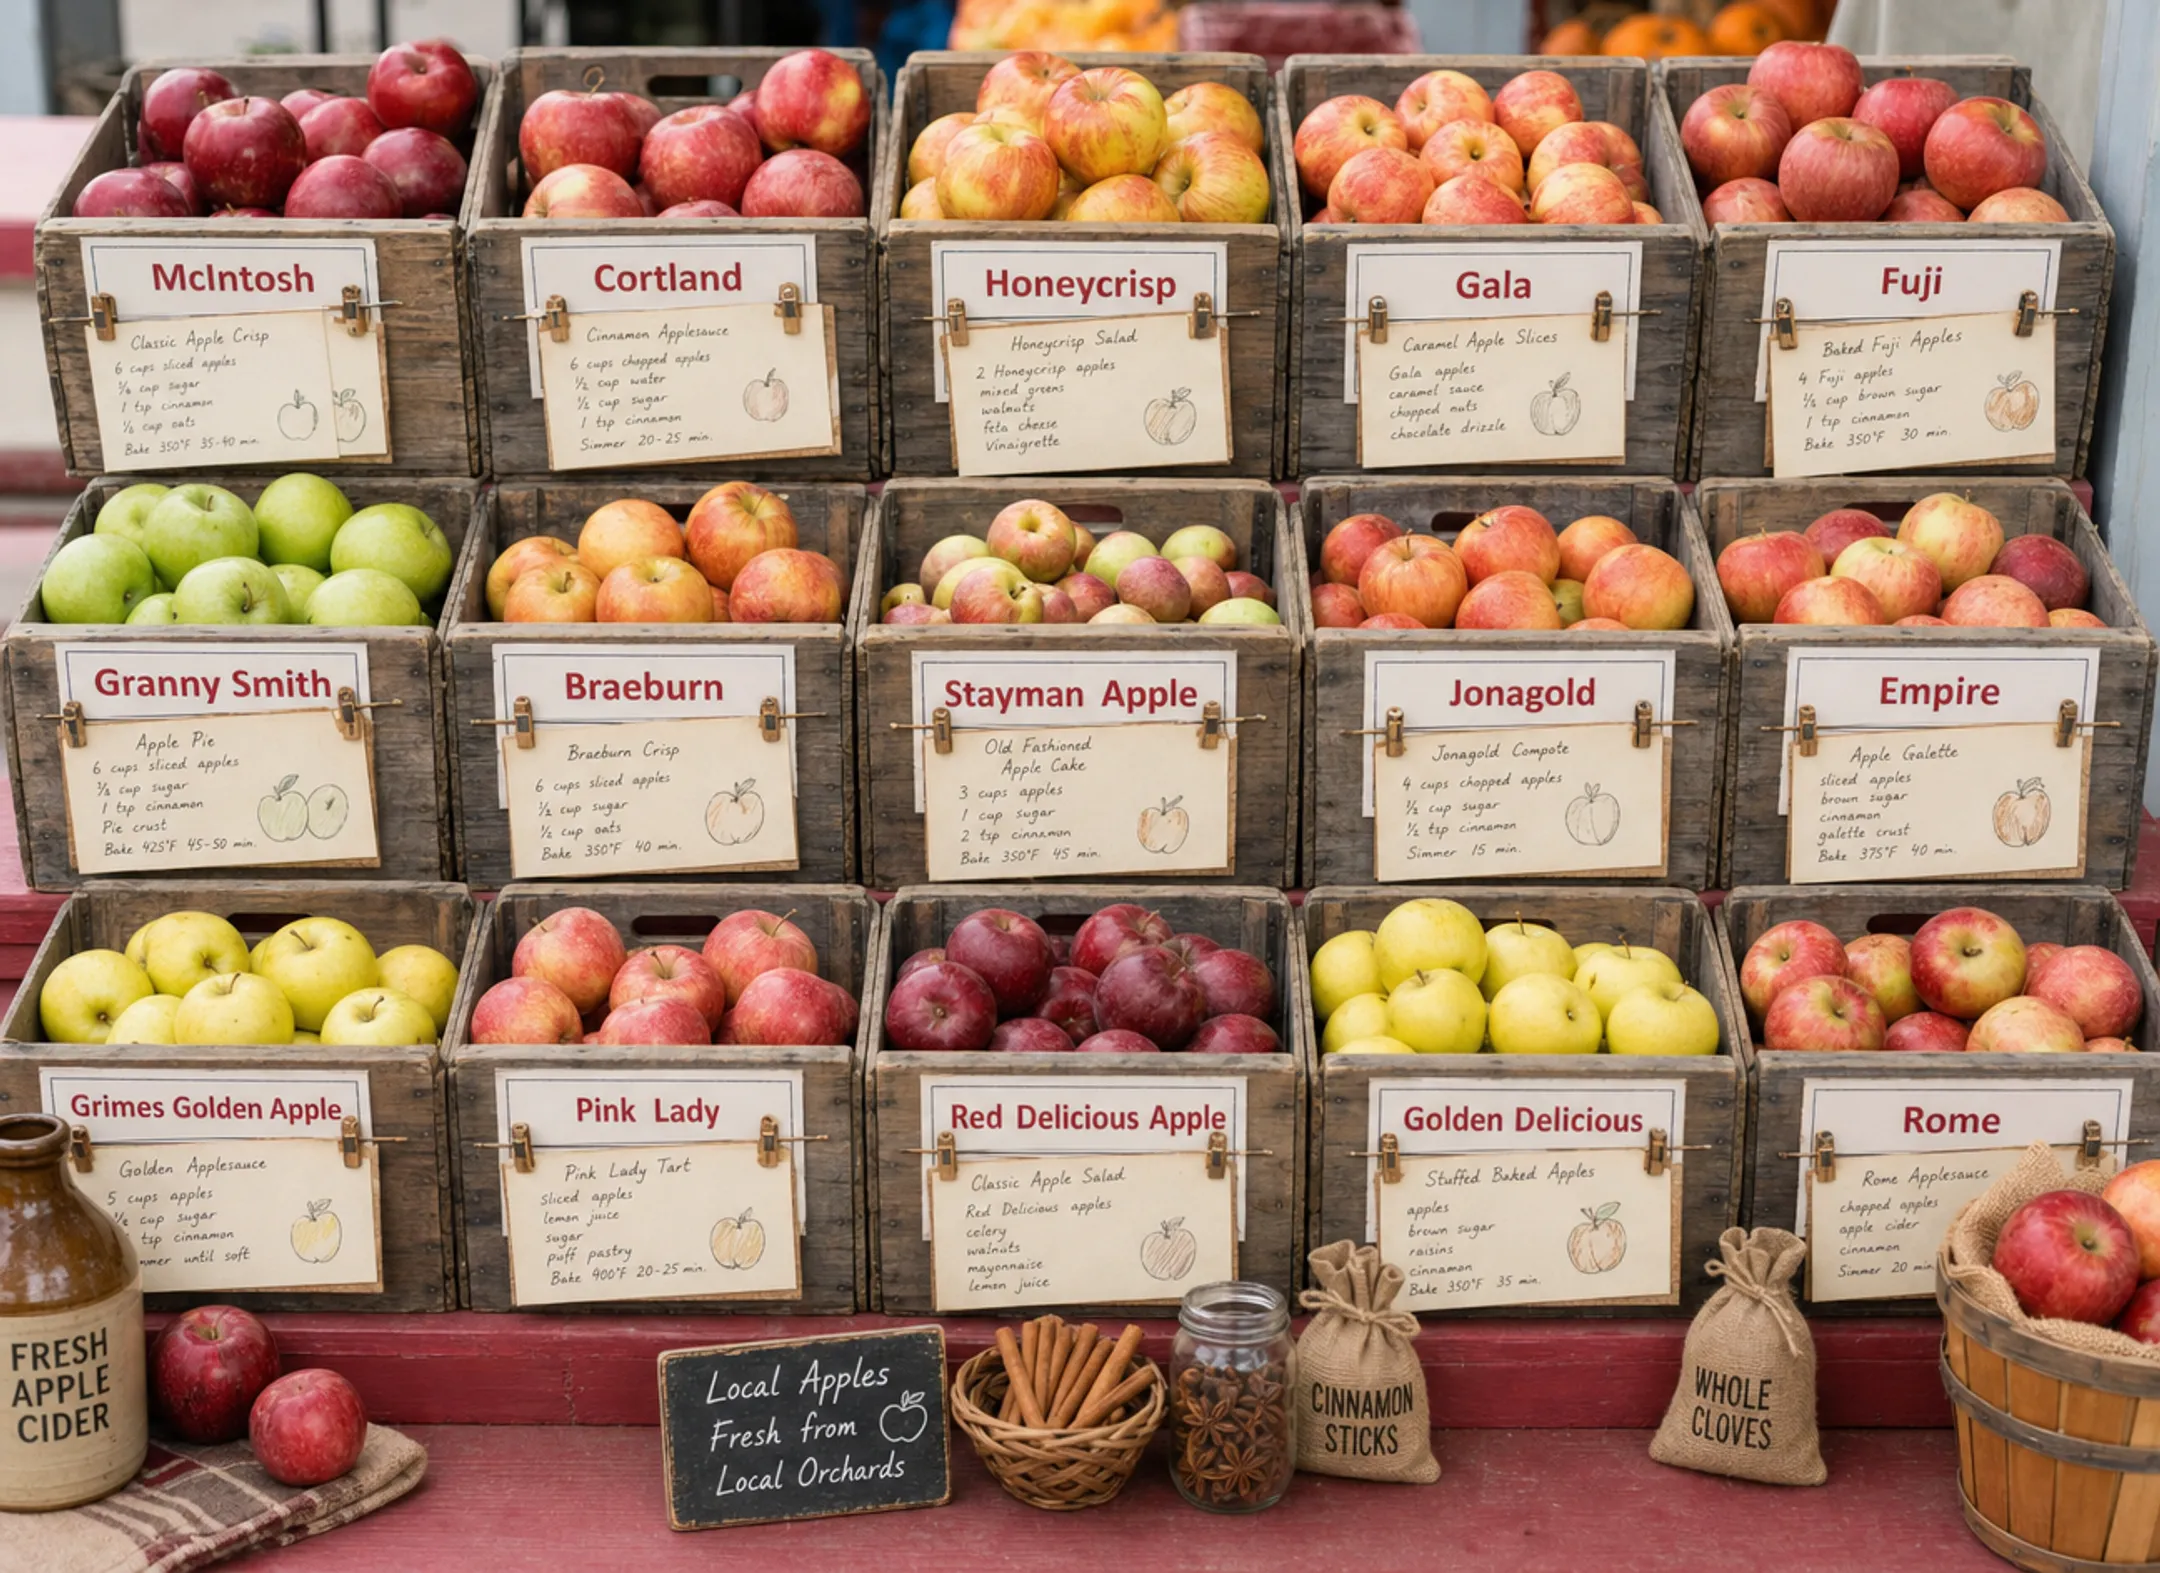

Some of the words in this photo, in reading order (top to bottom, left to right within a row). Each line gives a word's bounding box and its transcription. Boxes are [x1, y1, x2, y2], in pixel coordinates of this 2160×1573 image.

[152, 263, 314, 292] McIntosh
[594, 262, 742, 292] Cortland
[986, 268, 1176, 305] Honeycrisp
[1456, 270, 1531, 299] Gala
[1881, 266, 1942, 302] Fuji
[129, 334, 177, 352] Classic
[184, 328, 225, 353] Apple
[232, 326, 270, 348] Crisp
[586, 325, 650, 343] Cinnamon
[1010, 334, 1085, 358] Honeycrisp
[1094, 327, 1138, 346] Salad
[1402, 333, 1460, 353] Caramel
[1465, 330, 1505, 353] Apple
[1515, 327, 1558, 345] Slices
[1909, 326, 1962, 354] Apples
[200, 354, 237, 373] apples
[674, 349, 711, 368] apples
[993, 362, 1066, 383] Honeycrisp
[1075, 357, 1116, 378] apples
[1388, 364, 1422, 382] Gala
[1434, 360, 1476, 382] apples
[1853, 363, 1893, 385] apples
[631, 394, 668, 412] sugar
[1024, 384, 1065, 402] greens
[1904, 384, 1942, 403] sugar
[1389, 422, 1451, 440] chocolate
[1460, 417, 1506, 434] drizzle
[1900, 427, 1919, 442] 30
[579, 437, 626, 452] Simmer
[985, 434, 1060, 456] Vinaigrette
[94, 668, 220, 704] Granny
[232, 669, 331, 698] Smith
[565, 671, 723, 701] Braeburn
[945, 680, 1083, 714] Stayman
[1101, 678, 1197, 714] Apple
[1449, 677, 1595, 713] Jonagold
[1880, 676, 2000, 712] Empire
[134, 732, 180, 758] Apple
[191, 729, 215, 748] Pie
[566, 743, 632, 762] Braeburn
[642, 739, 680, 762] Crisp
[984, 737, 1013, 755] Old
[1021, 734, 1092, 754] Fashioned
[1431, 742, 1501, 768] Jonagold
[1511, 740, 1569, 761] Compote
[92, 760, 102, 775] 6
[148, 756, 188, 772] sliced
[196, 753, 240, 774] apples
[1848, 745, 1890, 770] Apple
[1901, 742, 1958, 762] Galette
[1000, 757, 1042, 782] Apple
[1050, 756, 1086, 773] Cake
[1520, 769, 1562, 790] apples
[1819, 772, 1859, 787] sliced
[1868, 770, 1912, 790] apples
[151, 782, 188, 798] sugar
[534, 777, 544, 793] 6
[588, 772, 624, 789] sliced
[631, 770, 671, 790] apples
[958, 784, 968, 800] 3
[1018, 781, 1063, 804] apples
[591, 801, 629, 818] sugar
[1015, 808, 1056, 826] sugar
[1461, 801, 1500, 818] sugar
[101, 819, 123, 834] Pie
[131, 817, 167, 833] crust
[1816, 825, 1866, 847] galette
[1875, 822, 1911, 838] crust
[634, 839, 652, 853] 40
[1052, 846, 1070, 860] 45
[1406, 844, 1457, 860] Simmer
[1471, 842, 1487, 856] 15
[1910, 843, 1928, 857] 40
[71, 1094, 164, 1118] Grimes
[173, 1095, 262, 1119] Golden
[270, 1096, 342, 1125] Apple
[577, 1097, 636, 1122] Pink
[655, 1097, 720, 1129] Lady
[951, 1103, 1002, 1129] Red
[1017, 1103, 1139, 1130] Delicious
[1149, 1104, 1226, 1136] Apple
[1404, 1105, 1502, 1131] Golden
[1515, 1106, 1643, 1132] Delicious
[1904, 1106, 2000, 1134] Rome
[118, 1158, 174, 1179] Golden
[564, 1163, 597, 1182] Pink
[608, 1159, 648, 1185] Lady
[656, 1156, 692, 1174] Tart
[970, 1173, 1020, 1192] Classic
[1029, 1169, 1072, 1193] Apple
[1081, 1165, 1126, 1184] Salad
[1424, 1167, 1481, 1188] Stuffed
[1546, 1161, 1595, 1185] Apples
[1861, 1169, 1898, 1187] Rome
[107, 1190, 117, 1206] 5
[169, 1185, 213, 1207] apples
[590, 1186, 633, 1208] apples
[964, 1203, 992, 1218] Red
[1001, 1201, 1059, 1217] Delicious
[1070, 1195, 1112, 1216] apples
[1899, 1194, 1938, 1215] apples
[176, 1211, 217, 1228] sugar
[543, 1211, 580, 1225] lemon
[1406, 1199, 1450, 1221] apples
[965, 1223, 1007, 1244] celery
[1457, 1223, 1496, 1240] sugar
[1838, 1219, 1874, 1239] apple
[1884, 1217, 1920, 1232] cider
[544, 1232, 584, 1251] sugar
[183, 1249, 215, 1264] until
[224, 1245, 250, 1263] soft
[586, 1244, 633, 1264] pastry
[1837, 1263, 1882, 1278] Simmer
[1890, 1260, 1908, 1274] 20
[968, 1278, 1007, 1292] lemon
[1496, 1274, 1513, 1288] 35
[11, 1327, 108, 1371] FRESH
[12, 1363, 110, 1407] APPLE
[706, 1364, 780, 1404] Local
[799, 1356, 890, 1406] Apples
[1696, 1365, 1772, 1411] WHOLE
[1311, 1381, 1413, 1419] CINNAMON
[18, 1402, 110, 1443] CIDER
[710, 1416, 781, 1452] Fresh
[800, 1411, 857, 1443] from
[1691, 1405, 1772, 1451] CLOVES
[1324, 1423, 1398, 1456] STICKS
[716, 1459, 783, 1496] Local
[798, 1450, 904, 1487] Orchards
